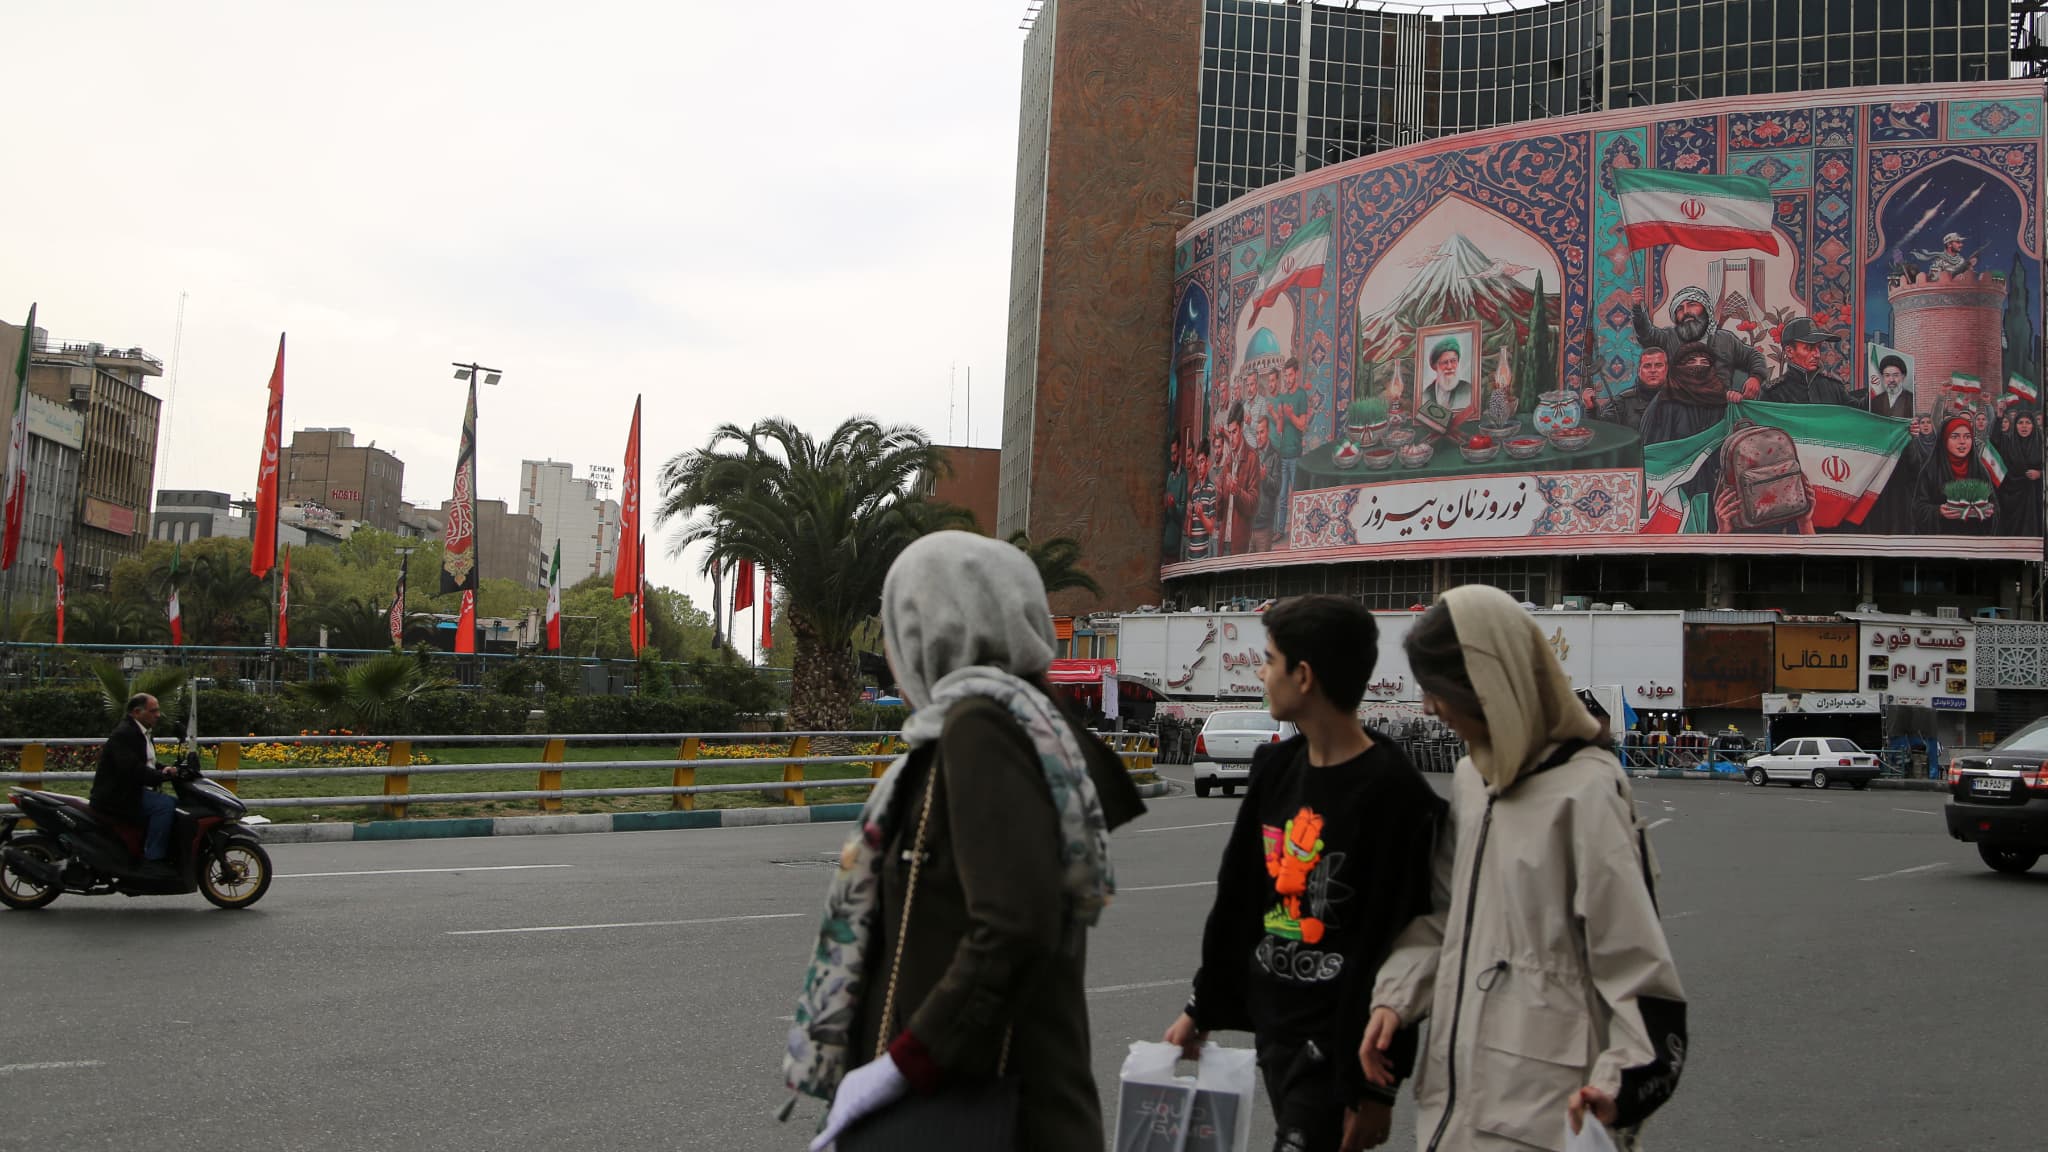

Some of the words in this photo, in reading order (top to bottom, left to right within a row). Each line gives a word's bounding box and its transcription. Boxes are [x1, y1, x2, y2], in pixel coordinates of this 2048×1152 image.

[587, 480, 613, 490] HOTEL
[333, 489, 361, 501] HOSTEL
[1873, 627, 1911, 651] فود
[1914, 628, 1966, 650] فست
[1893, 663, 1943, 687] آرام
[1638, 680, 1674, 699] موزه
[1816, 698, 1843, 709] برادران
[1843, 698, 1867, 709] موکب
[1136, 1098, 1207, 1122] SQUD
